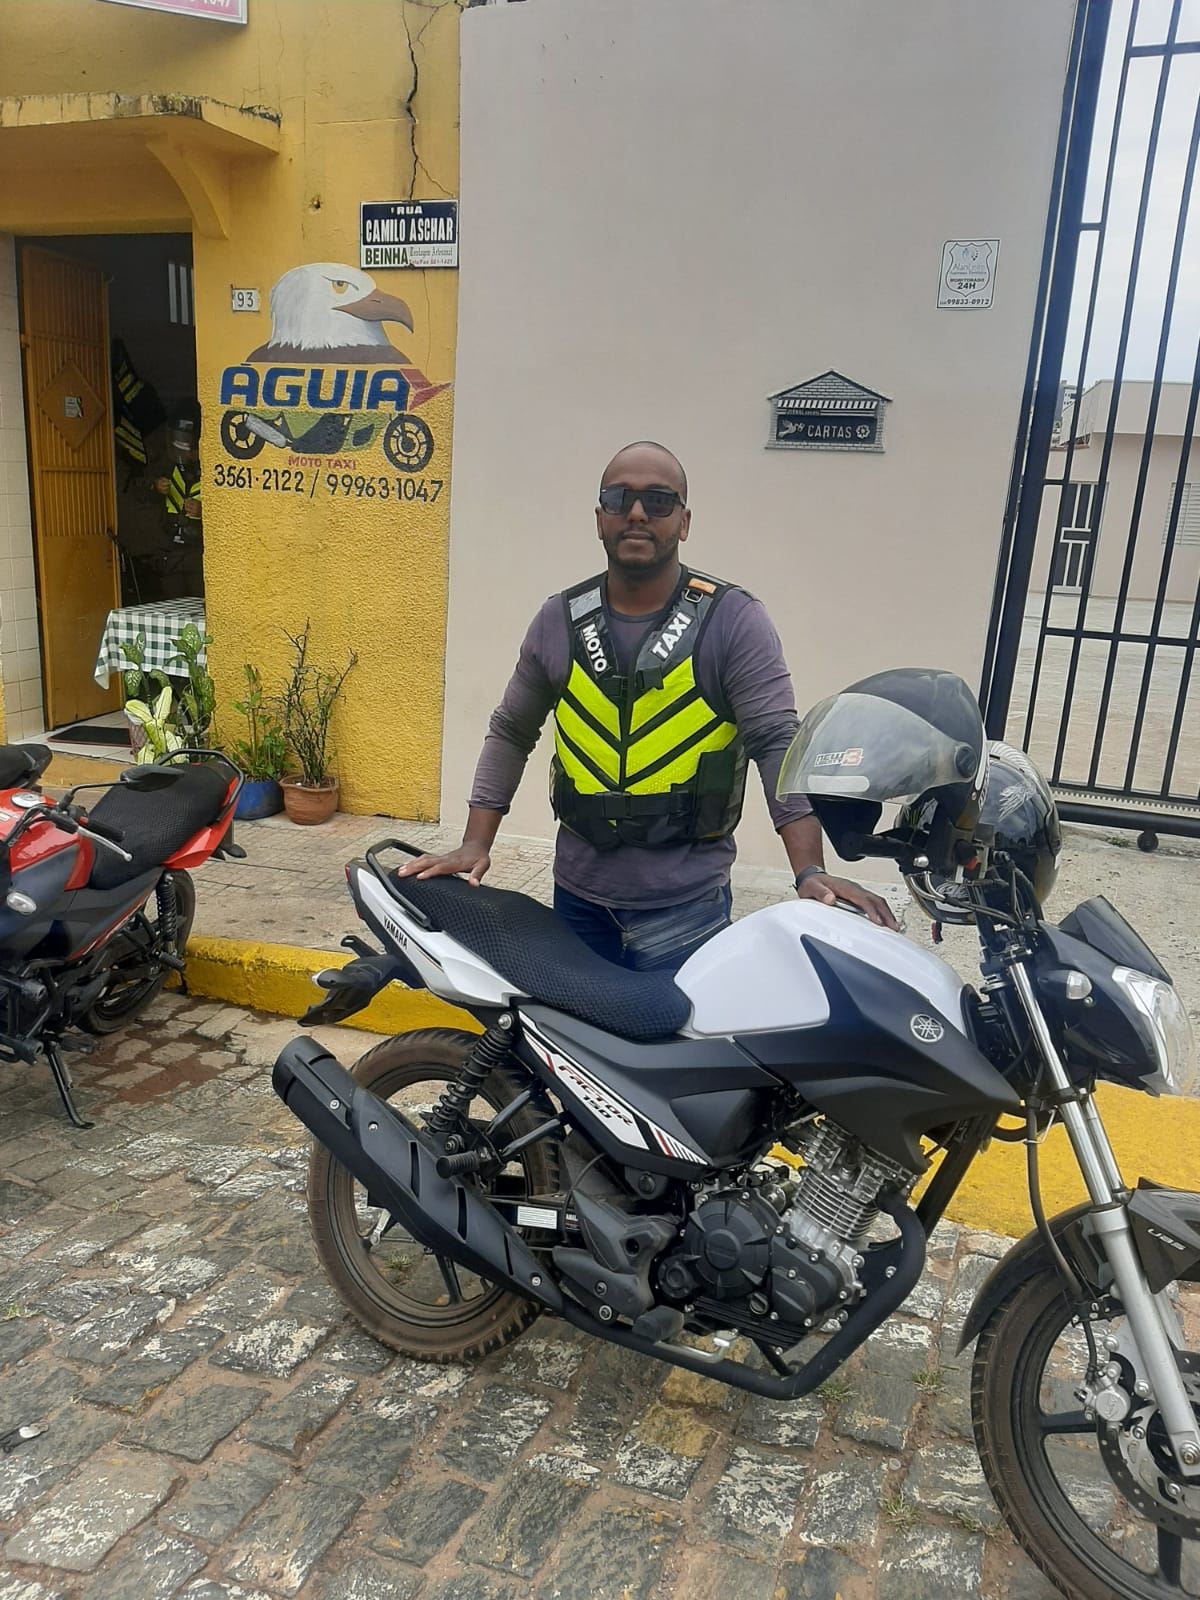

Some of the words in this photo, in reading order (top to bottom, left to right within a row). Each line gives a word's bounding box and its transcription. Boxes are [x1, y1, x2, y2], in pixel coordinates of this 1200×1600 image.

[396, 205, 423, 215] RUA
[365, 218, 406, 243] CAMILO
[409, 216, 453, 241] ASCHAR
[365, 247, 409, 265] BEINHA
[957, 282, 977, 290] 24H
[237, 291, 254, 308] 93
[807, 424, 853, 439] CARTAS
[287, 456, 322, 469] MOTO
[325, 458, 357, 471] TAXI
[652, 612, 692, 659] TAXI
[582, 623, 608, 672] MOTO
[383, 915, 408, 950] YAMAHA
[558, 1065, 634, 1127] FACTOR
[582, 1094, 613, 1119] 150
